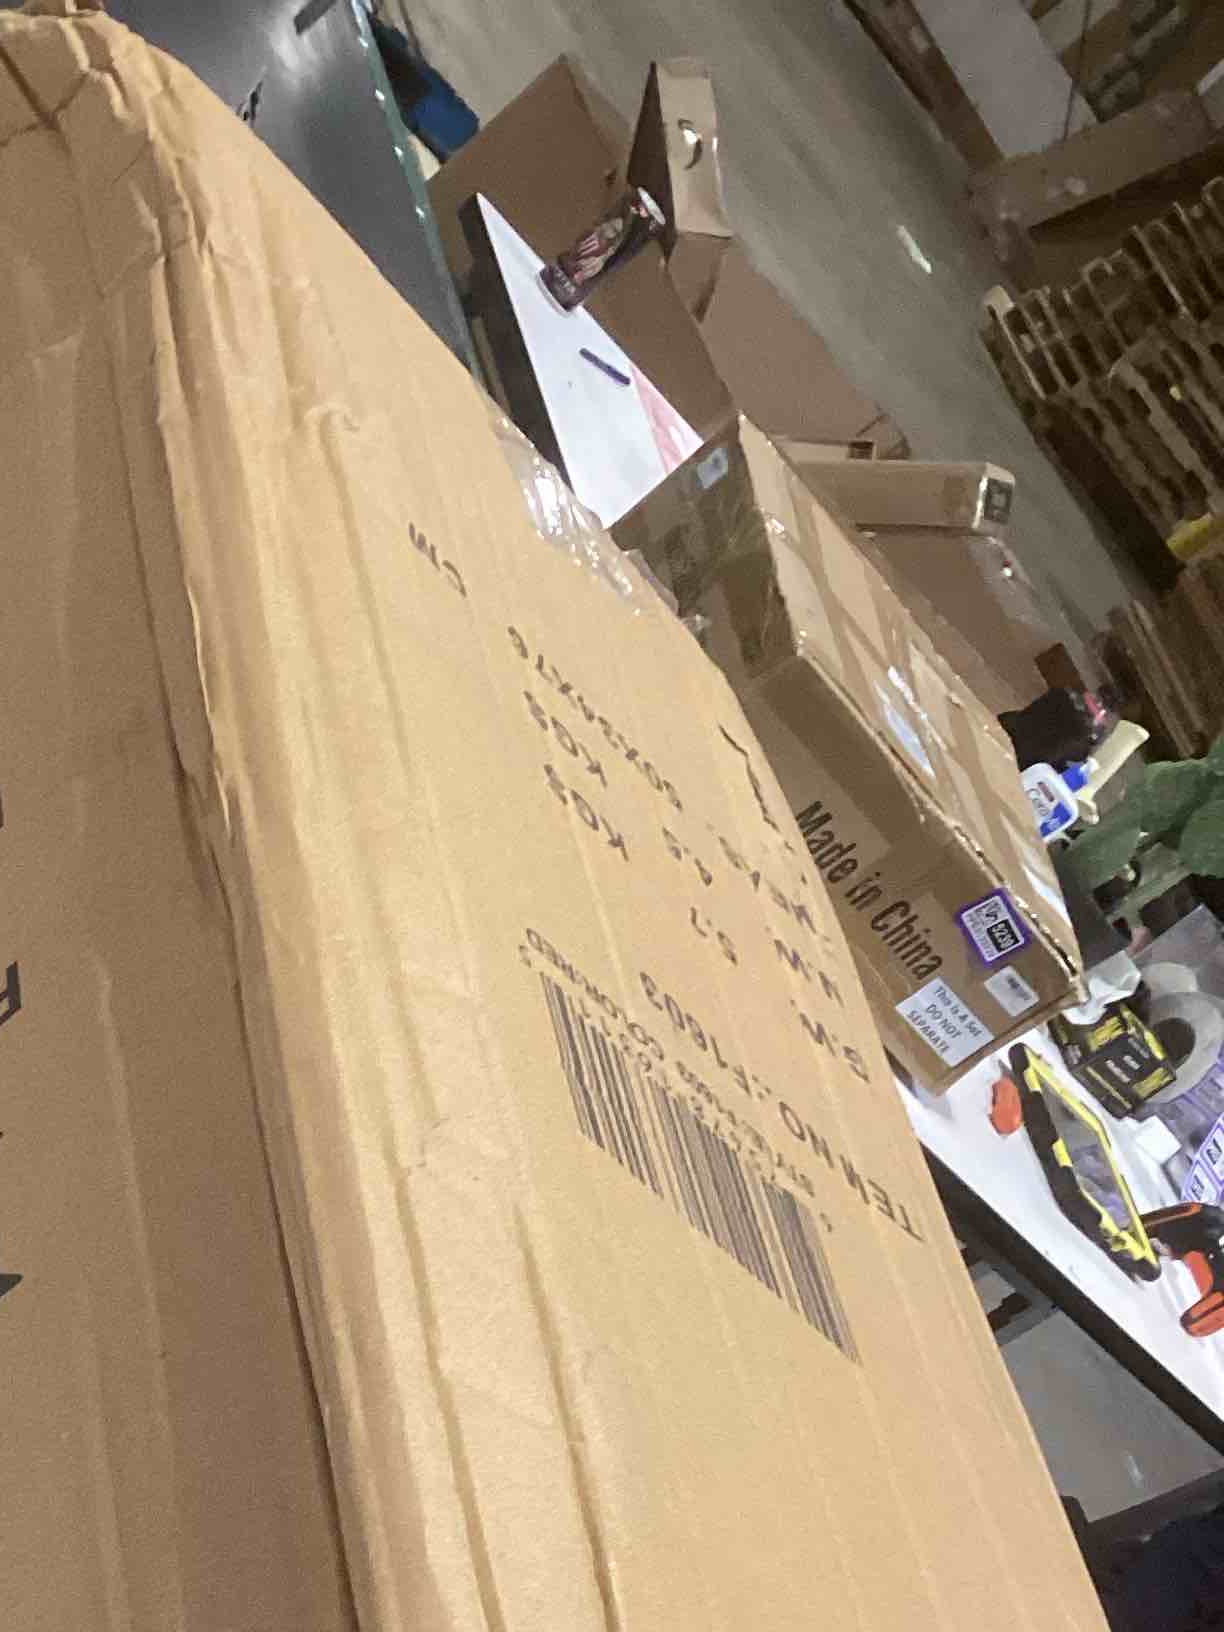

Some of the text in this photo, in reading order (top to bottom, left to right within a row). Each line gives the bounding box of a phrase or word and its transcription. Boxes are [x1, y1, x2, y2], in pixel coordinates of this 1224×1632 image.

[795, 800, 943, 980] Made in China
